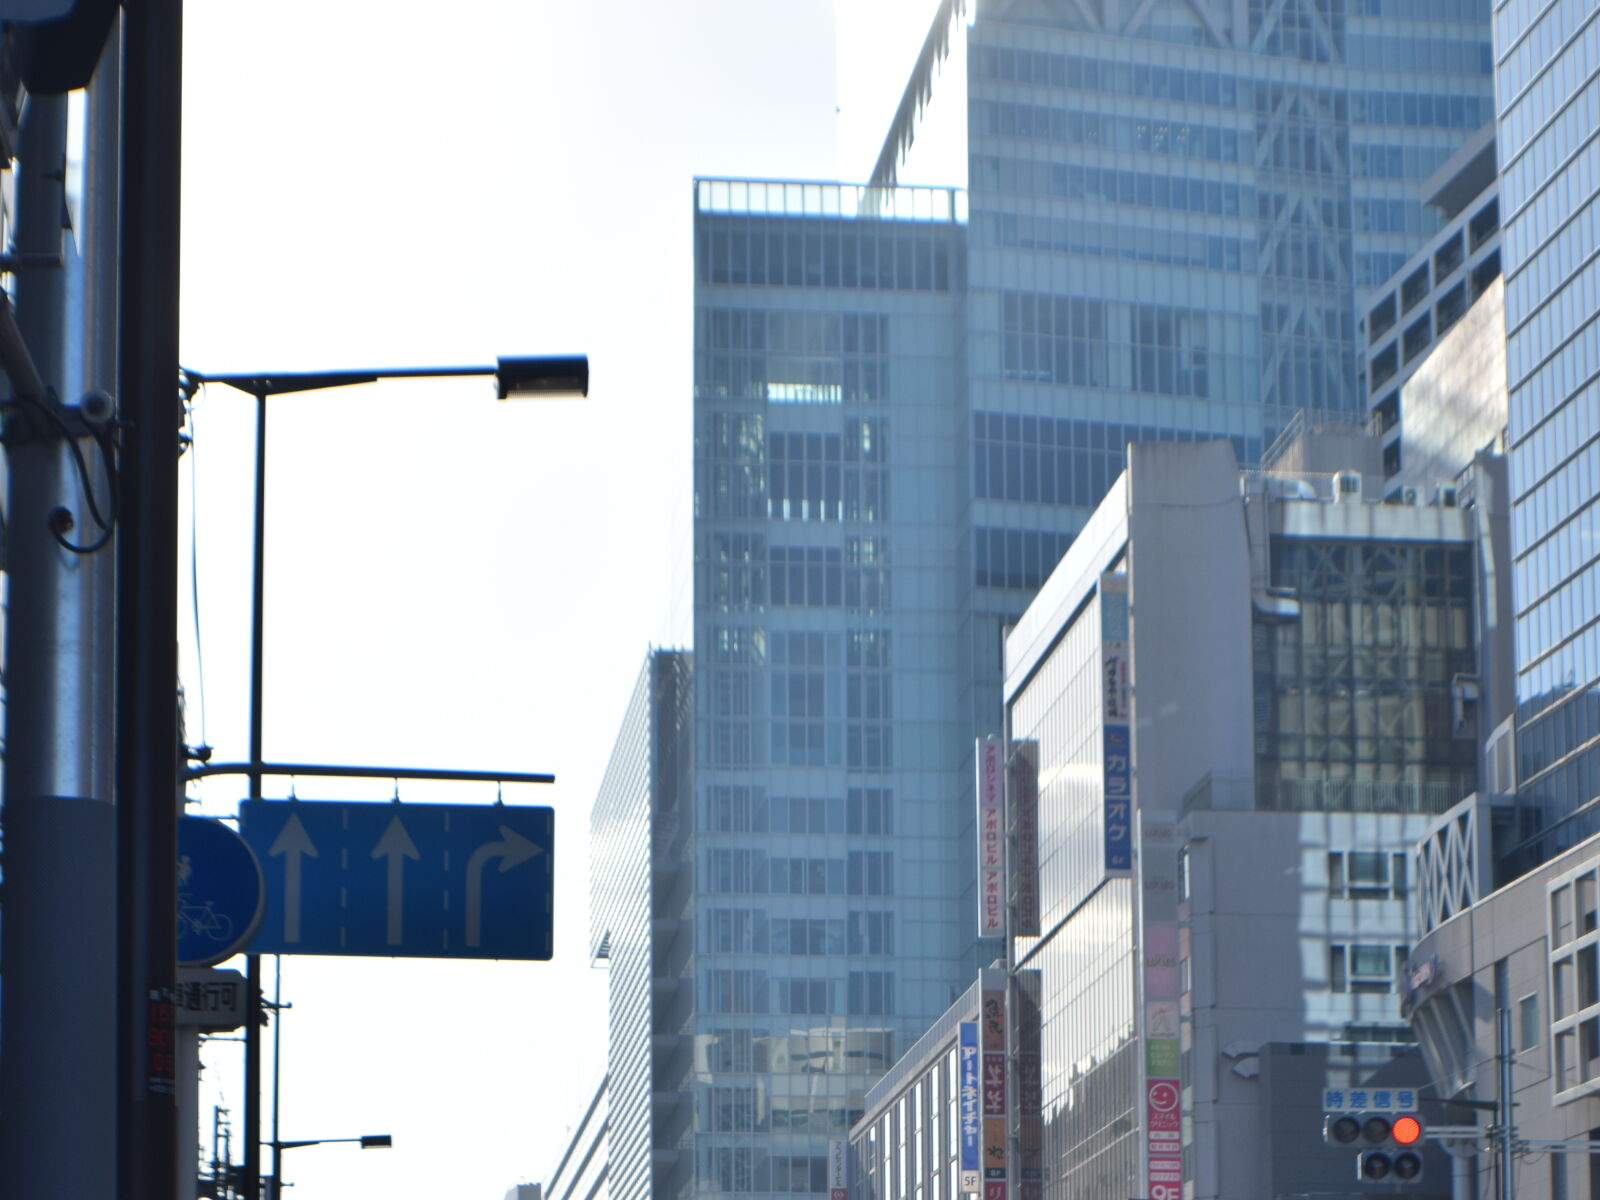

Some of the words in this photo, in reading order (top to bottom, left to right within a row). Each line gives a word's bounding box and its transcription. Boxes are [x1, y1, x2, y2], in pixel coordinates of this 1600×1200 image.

[1107, 754, 1127, 841] カラオケ
[985, 807, 998, 867] アポロビル
[986, 870, 999, 929] アポロビル
[1326, 1090, 1413, 1108] 時差信号
[964, 1176, 977, 1186] 5F
